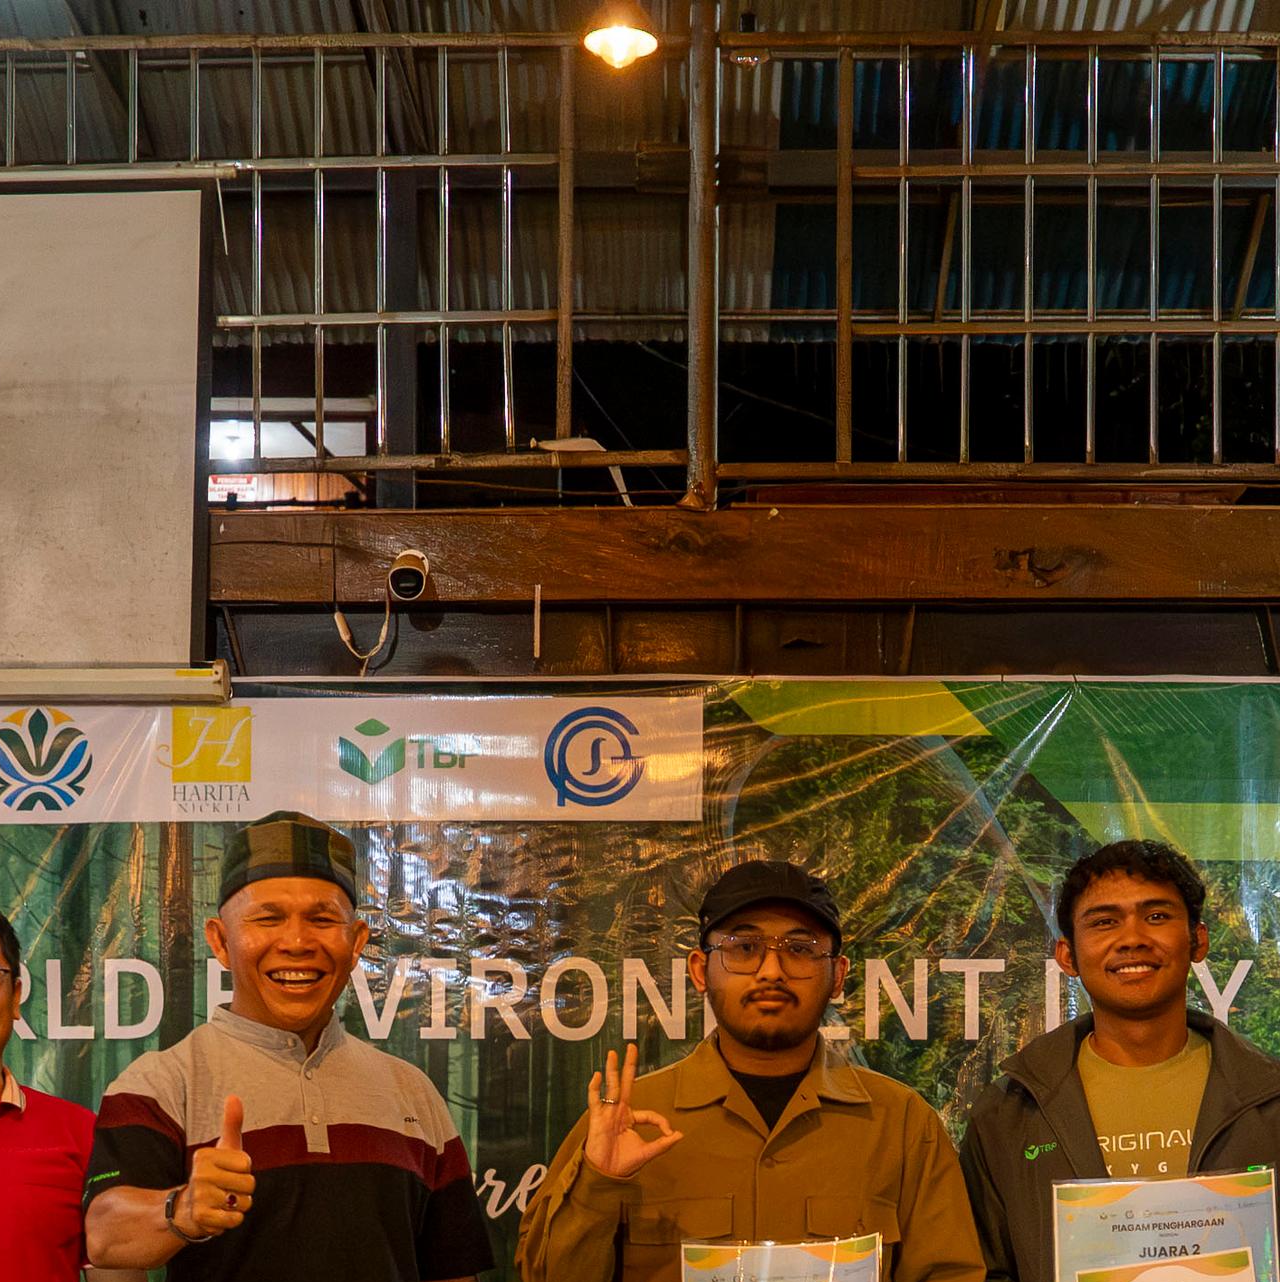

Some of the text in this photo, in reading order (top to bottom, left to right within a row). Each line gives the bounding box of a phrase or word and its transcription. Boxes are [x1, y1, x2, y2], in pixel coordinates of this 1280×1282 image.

[172, 784, 250, 801] HARITA
[206, 957, 1006, 1041] VIRONNT
[1097, 1129, 1193, 1153] RIGINAL
[1111, 1217, 1225, 1233] PIAGAM PENGHARGAAN
[1138, 1243, 1201, 1258] JUARA 2
